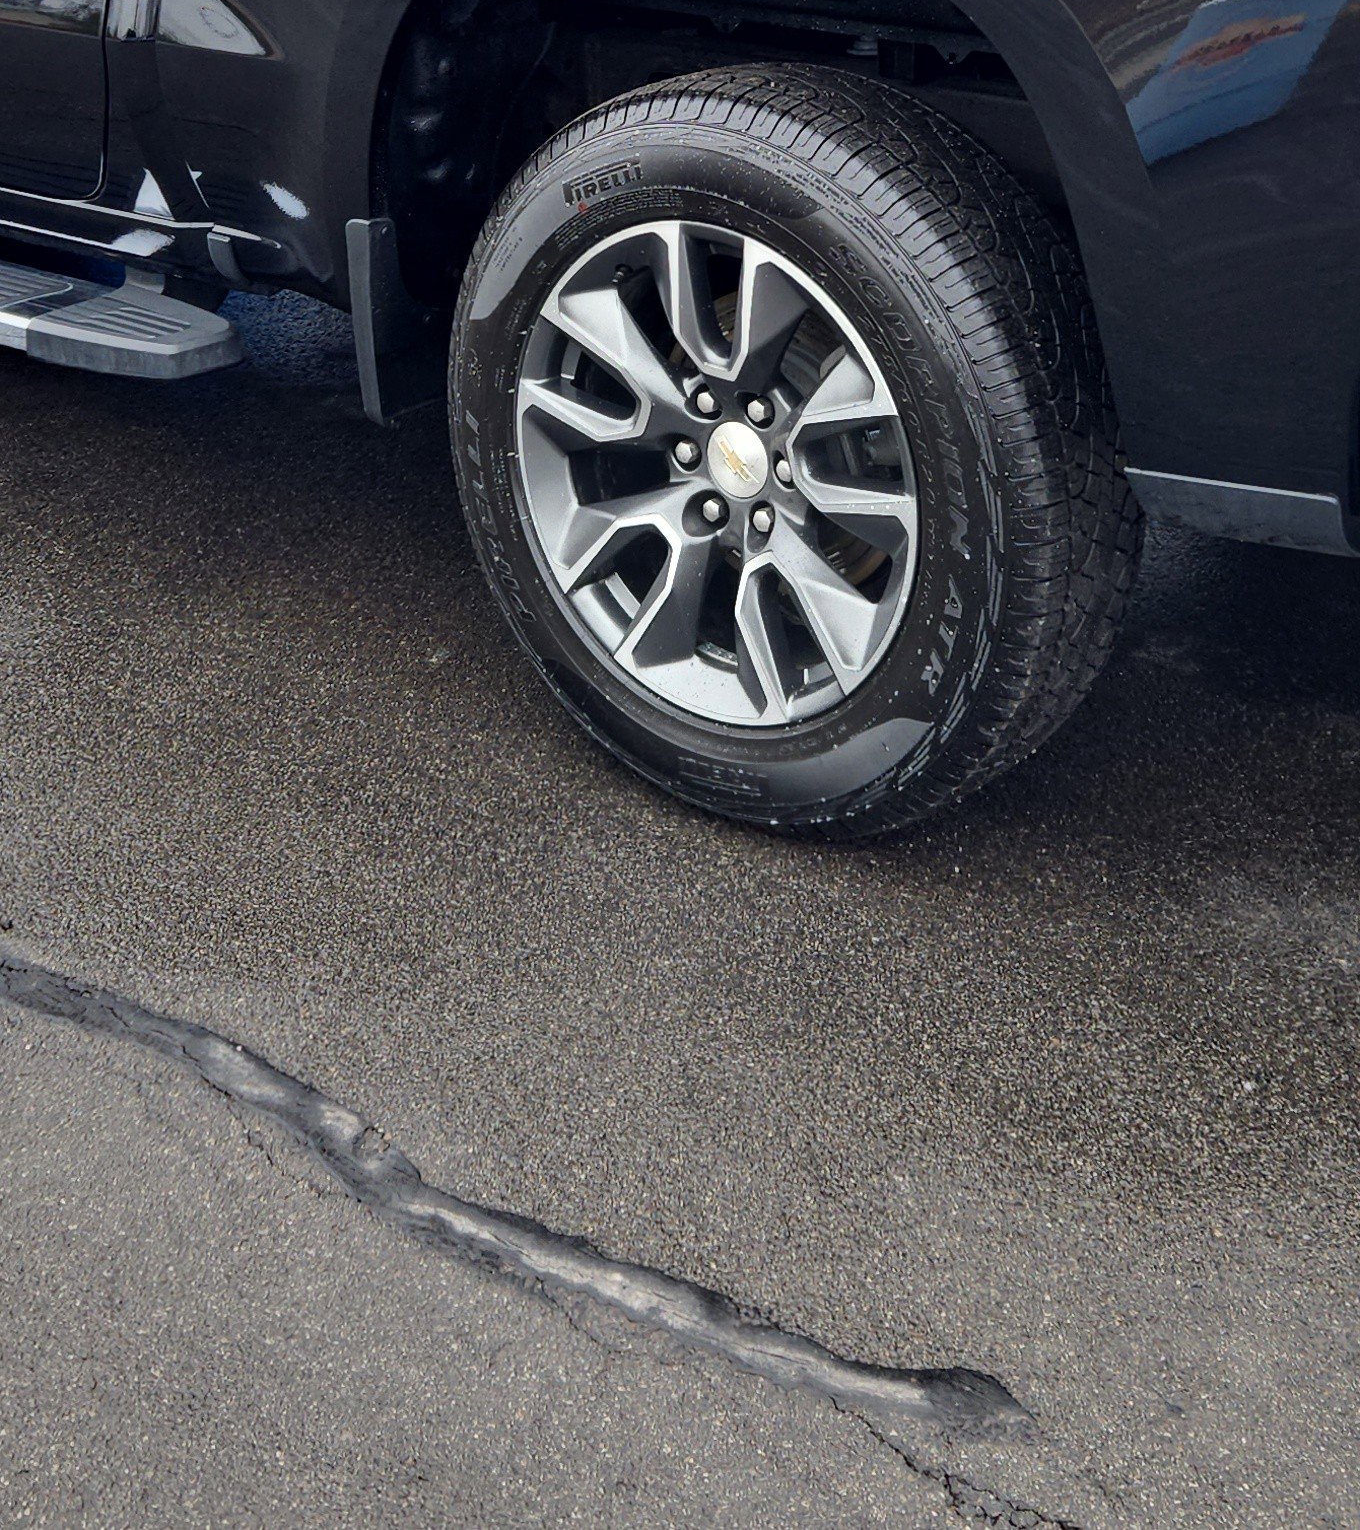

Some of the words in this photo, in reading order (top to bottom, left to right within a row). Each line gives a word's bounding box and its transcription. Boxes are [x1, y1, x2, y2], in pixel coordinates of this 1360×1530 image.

[562, 154, 643, 208] PIRELLI
[828, 243, 971, 560] SCORPION
[921, 574, 964, 697] ATR
